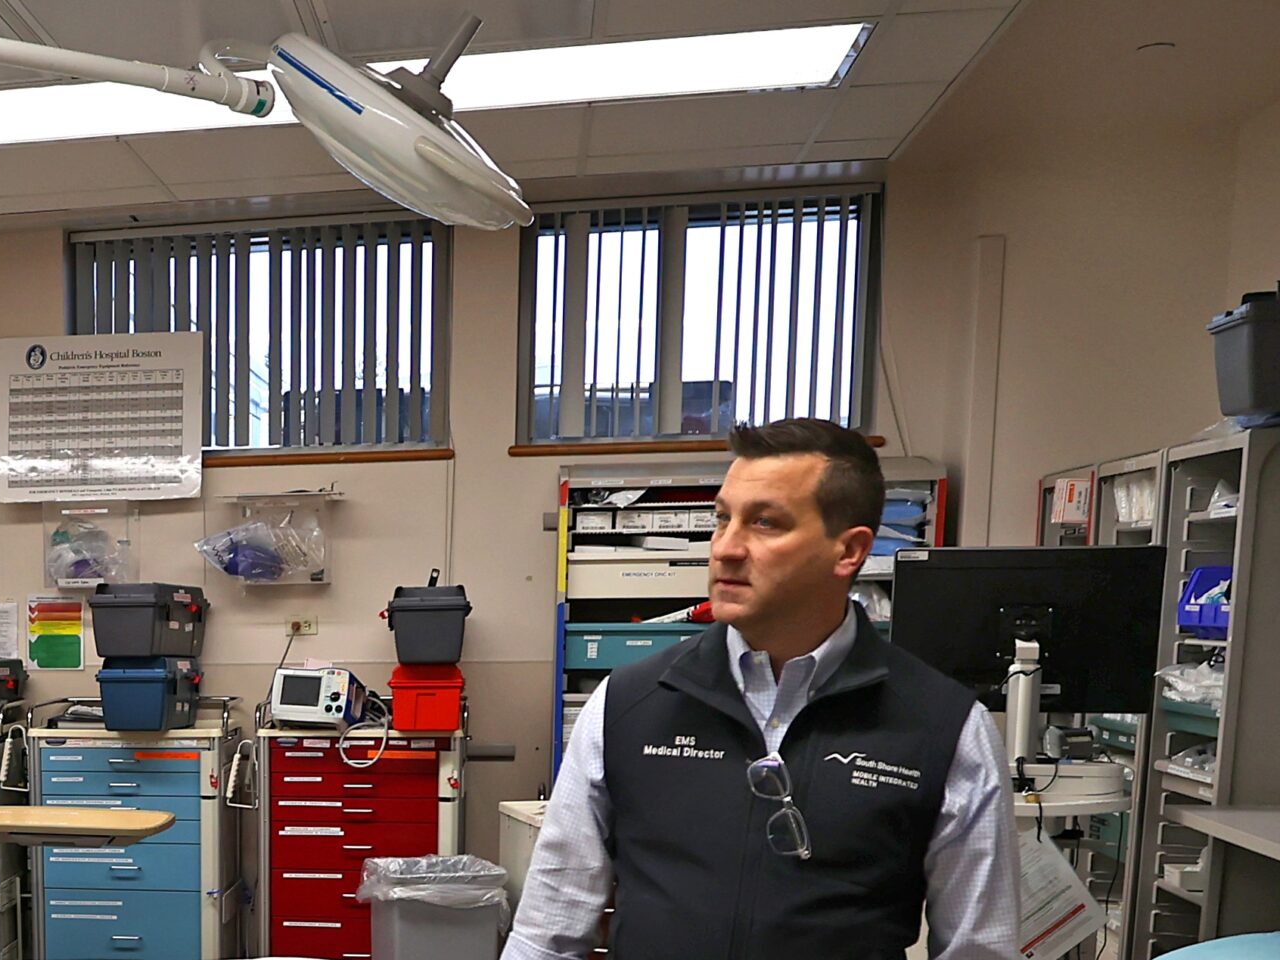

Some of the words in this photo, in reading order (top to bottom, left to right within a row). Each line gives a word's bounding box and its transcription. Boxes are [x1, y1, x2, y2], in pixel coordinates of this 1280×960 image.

[49, 351, 93, 362] Children's
[94, 349, 129, 362] Hospital
[131, 349, 162, 358] Boston
[675, 735, 696, 746] EMS
[643, 744, 681, 757] Medical
[683, 747, 725, 759] Director
[855, 758, 877, 768] South
[877, 761, 898, 772] Shore
[898, 765, 921, 778] Health
[851, 778, 878, 788] HEALTH
[852, 770, 879, 780] MOBILE
[879, 775, 919, 790] INTEGRATED
